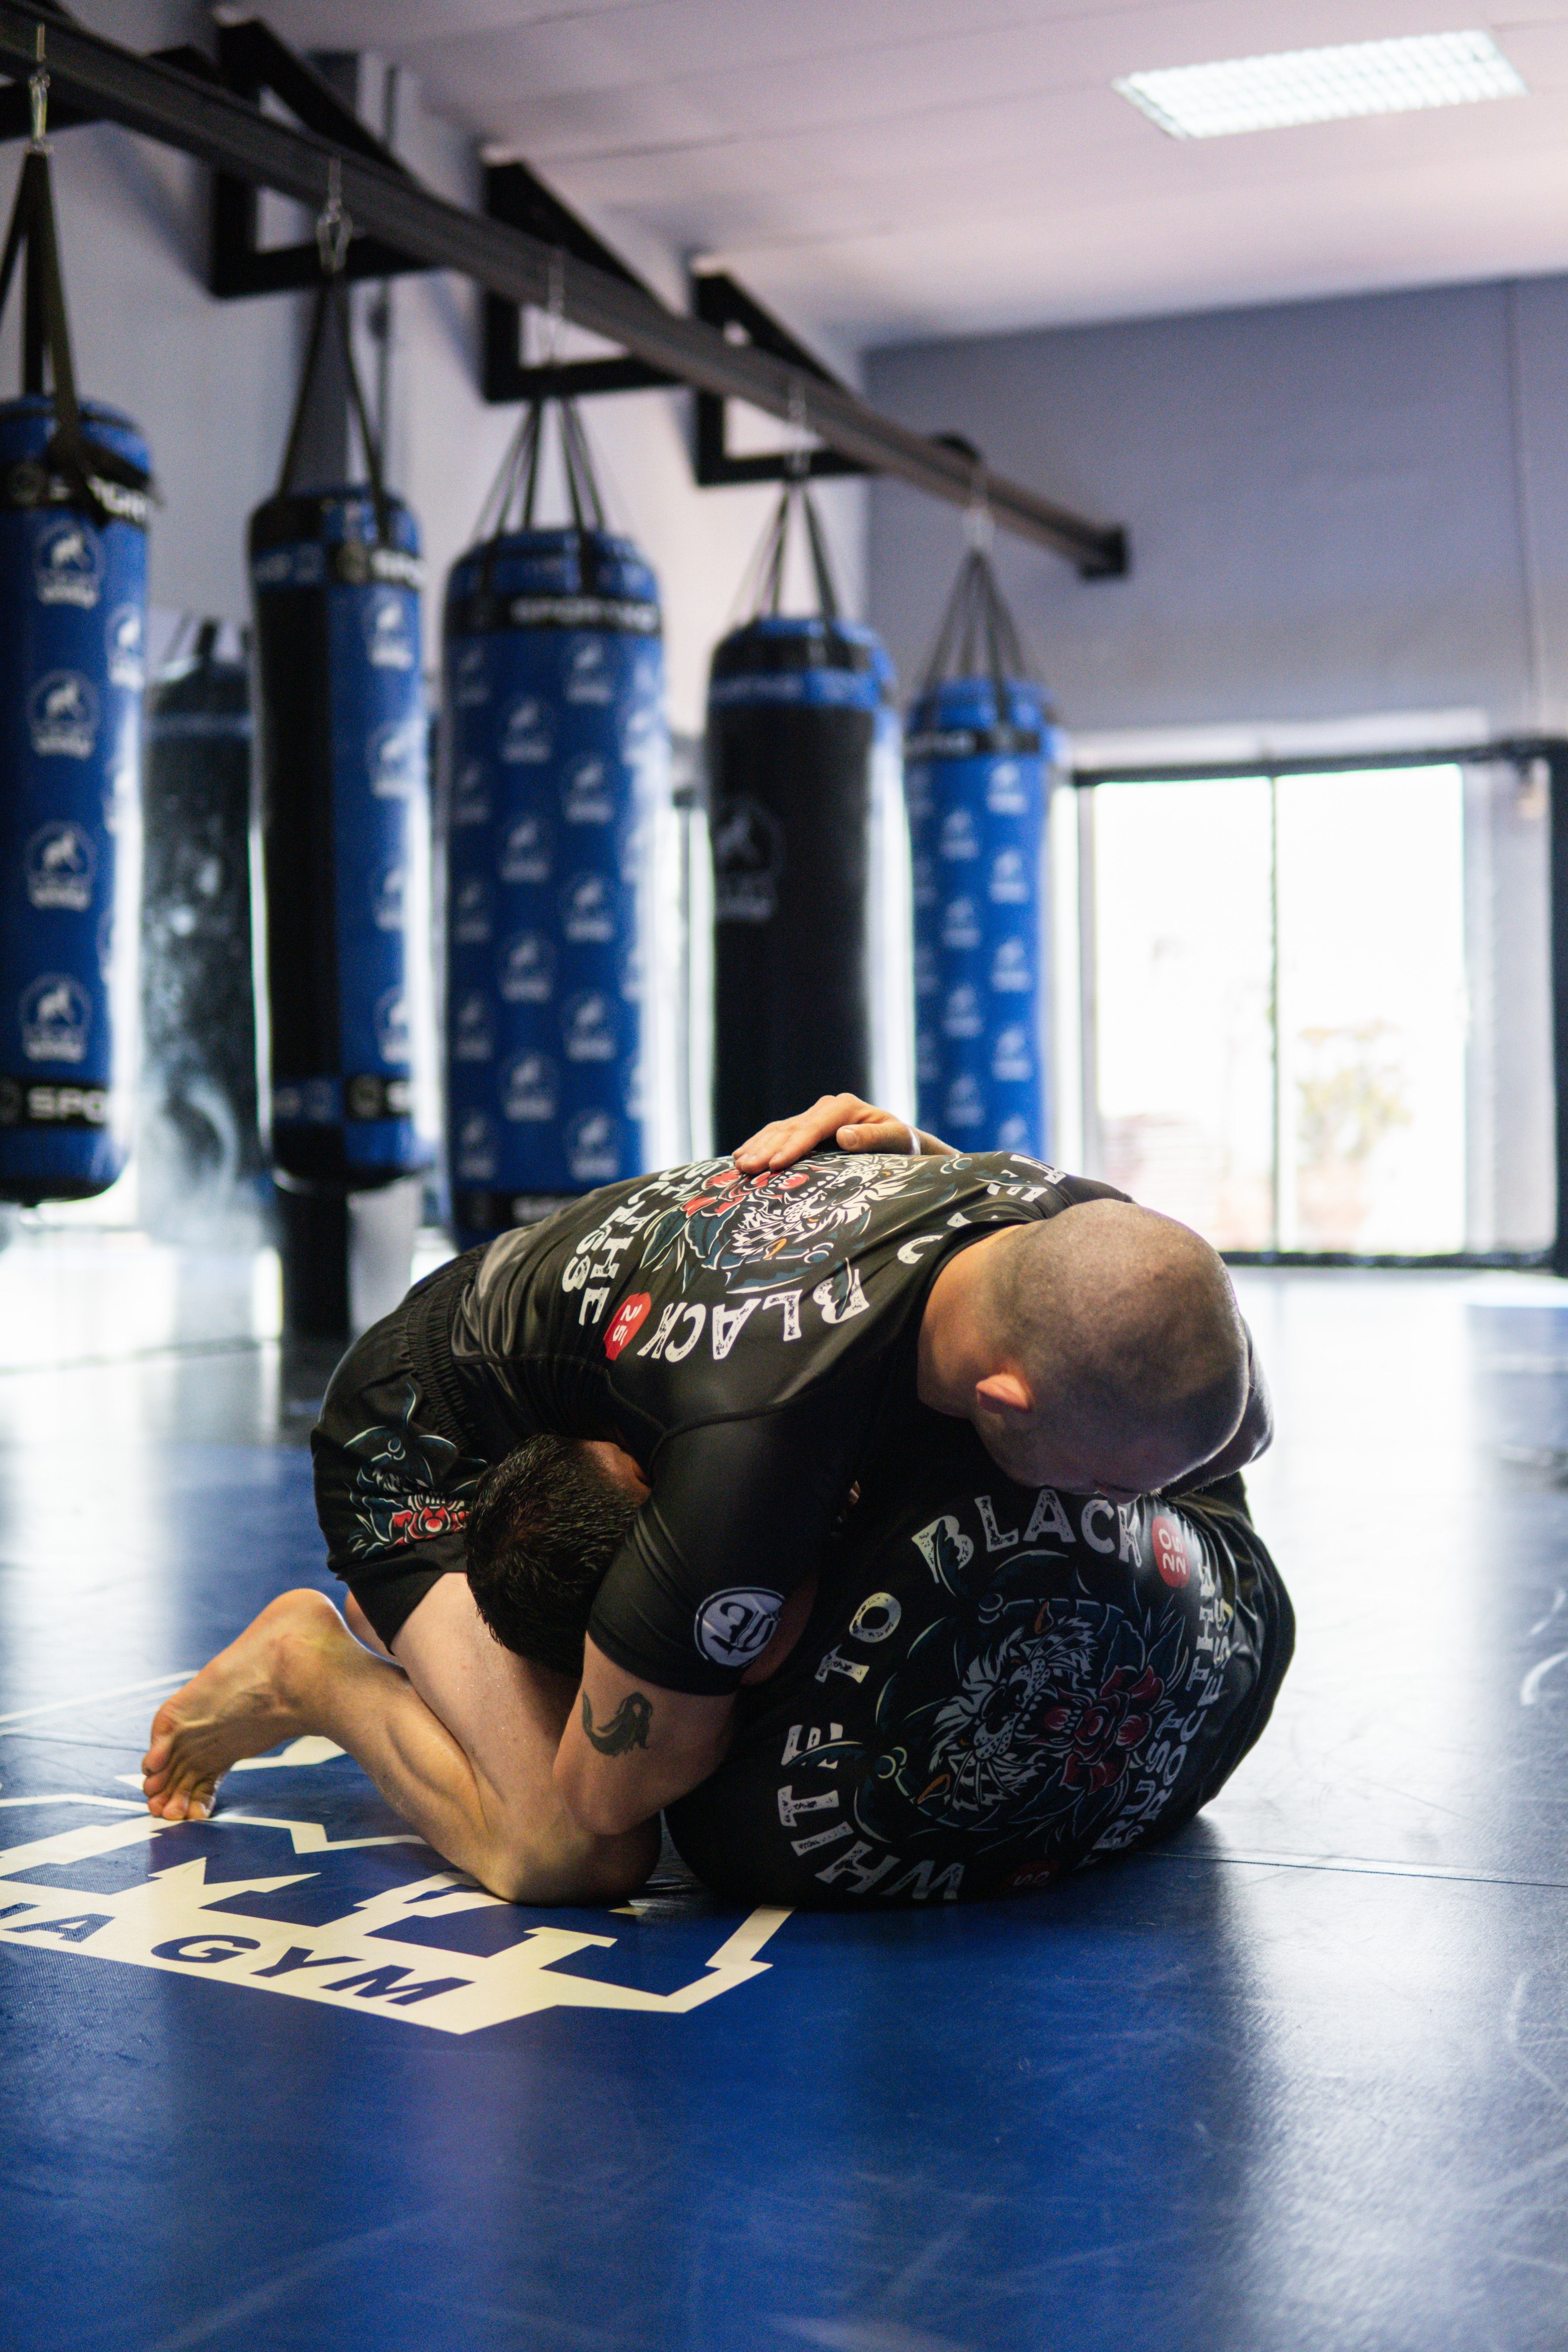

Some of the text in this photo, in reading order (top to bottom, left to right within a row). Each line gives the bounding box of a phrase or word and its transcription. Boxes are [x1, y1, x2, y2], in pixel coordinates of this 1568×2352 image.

[637, 1269, 870, 1363] BLACK
[911, 1489, 1143, 1584] BLACK
[1158, 1528, 1176, 1571] 20
[815, 1592, 902, 1684] TO
[777, 1722, 965, 1900] WHITE
[151, 1934, 475, 2006] GYM
